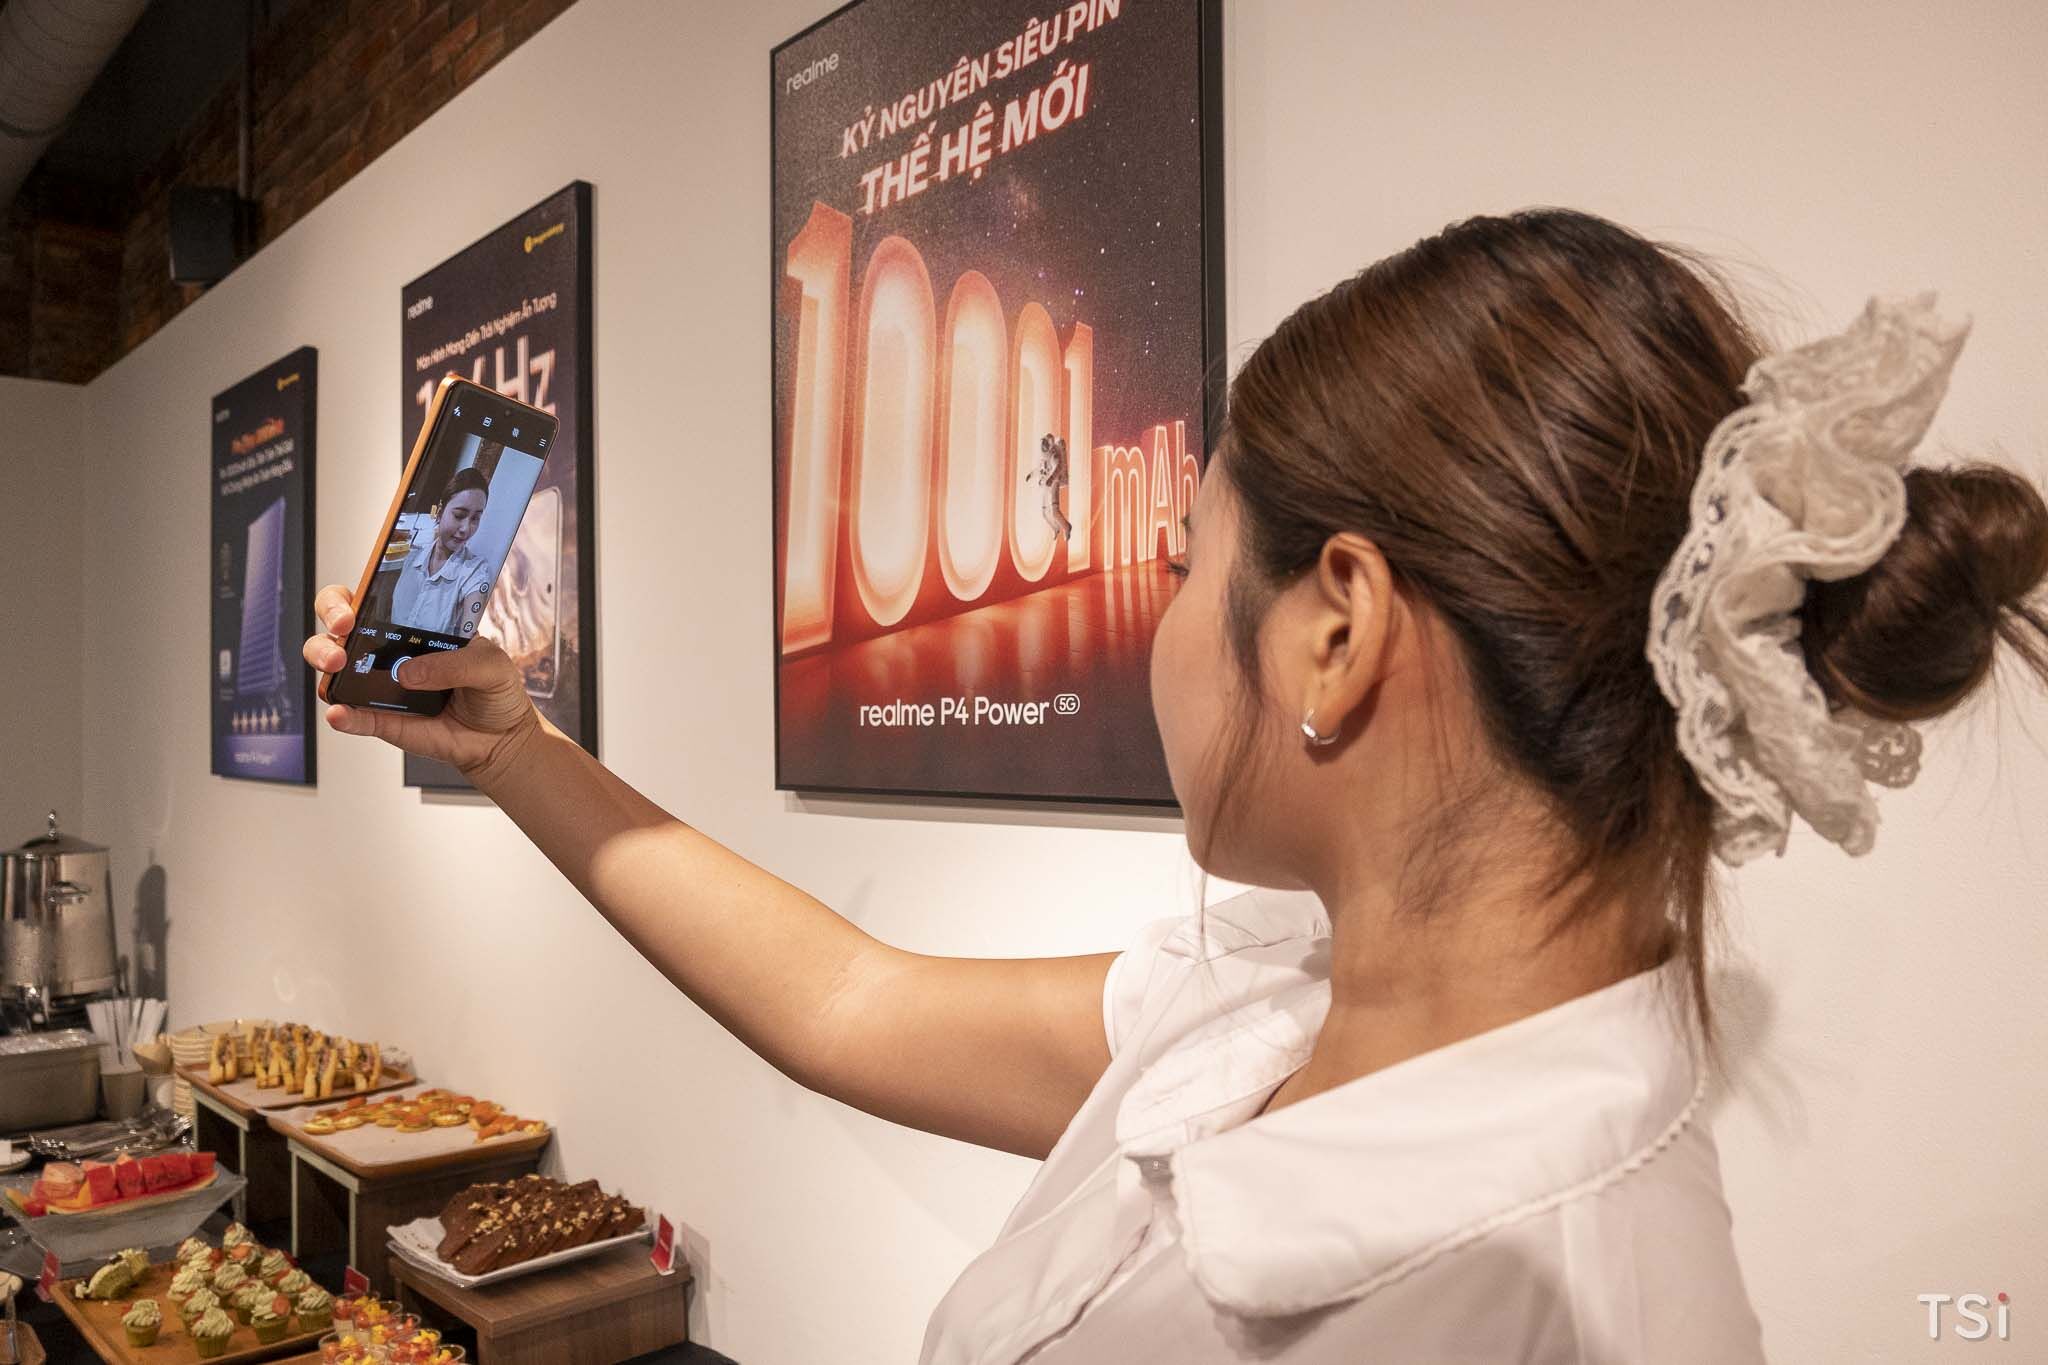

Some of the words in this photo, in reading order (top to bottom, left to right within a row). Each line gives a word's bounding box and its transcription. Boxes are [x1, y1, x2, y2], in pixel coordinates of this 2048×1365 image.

[785, 51, 840, 95] realme
[841, 107, 876, 160] KỶ
[879, 56, 990, 138] NGUYÊN
[992, 17, 1062, 80] SIÊU
[1065, 0, 1122, 43] PIN
[859, 121, 936, 216] THẾ
[935, 102, 996, 181] HỆ
[1000, 59, 1090, 154] MỚI
[782, 200, 1093, 656] 10001
[1104, 420, 1200, 572] mAh
[385, 632, 402, 641] VIDEO
[860, 698, 935, 727] realme
[940, 697, 969, 726] P4
[974, 697, 1050, 726] Power
[1057, 695, 1078, 713] 5G
